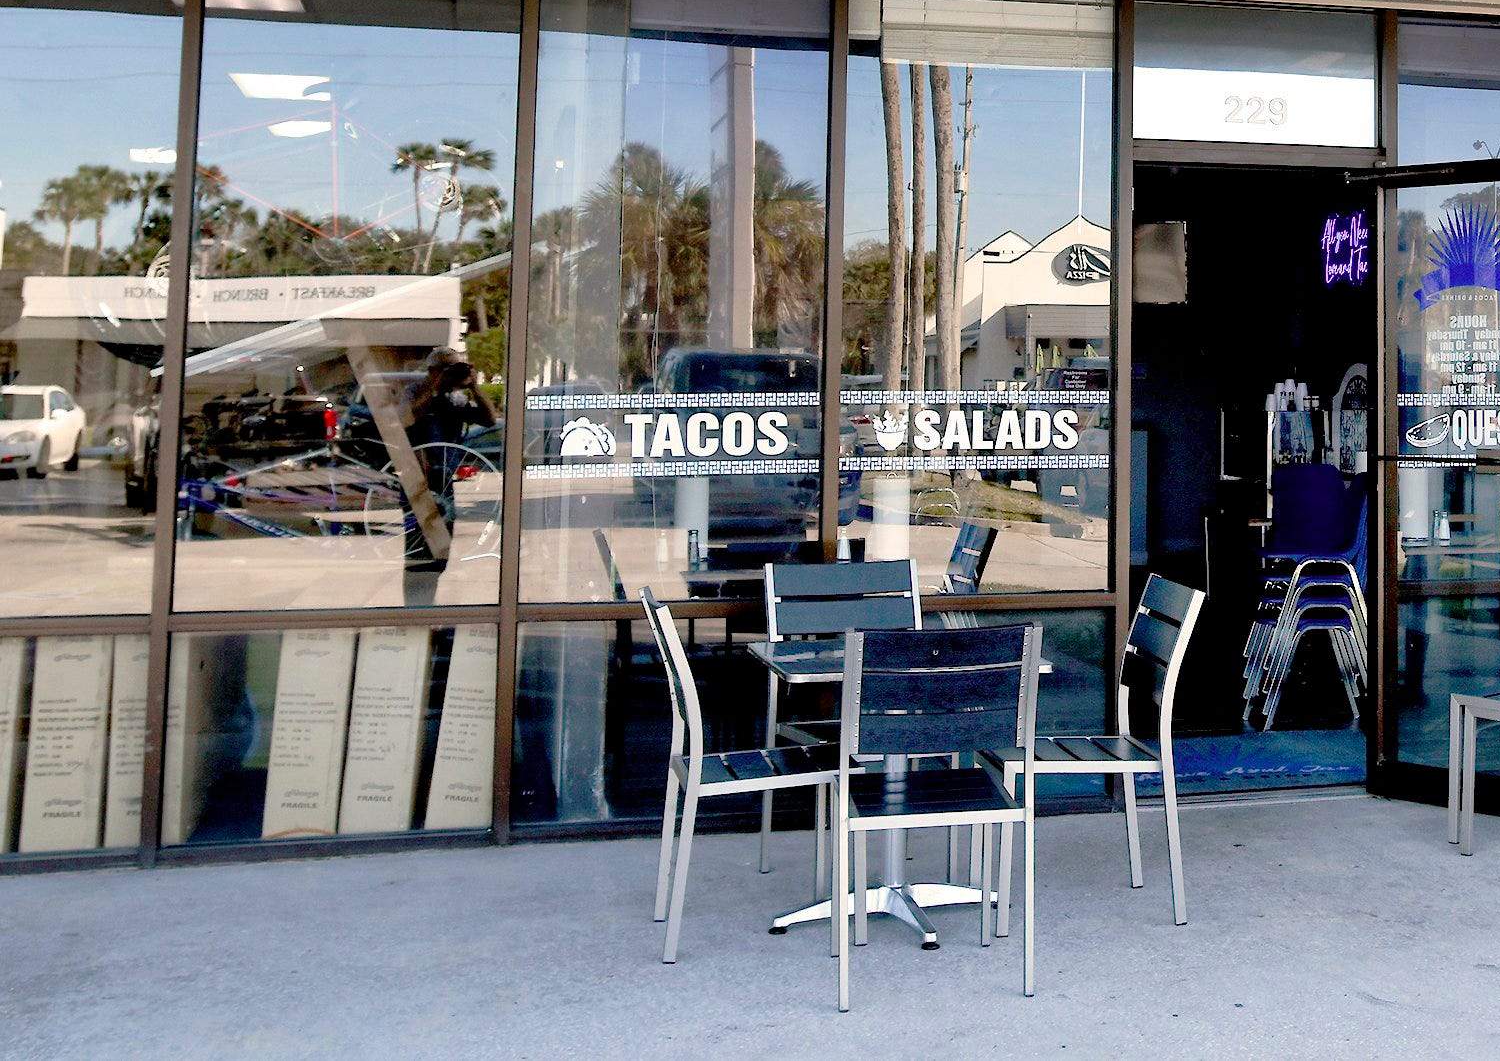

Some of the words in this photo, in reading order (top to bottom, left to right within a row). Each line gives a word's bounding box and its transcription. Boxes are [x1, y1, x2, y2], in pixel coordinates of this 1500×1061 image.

[1224, 96, 1288, 125] 229
[623, 411, 789, 459] TACOS
[913, 409, 1080, 451] SALADS
[445, 795, 479, 803] FRAGILE
